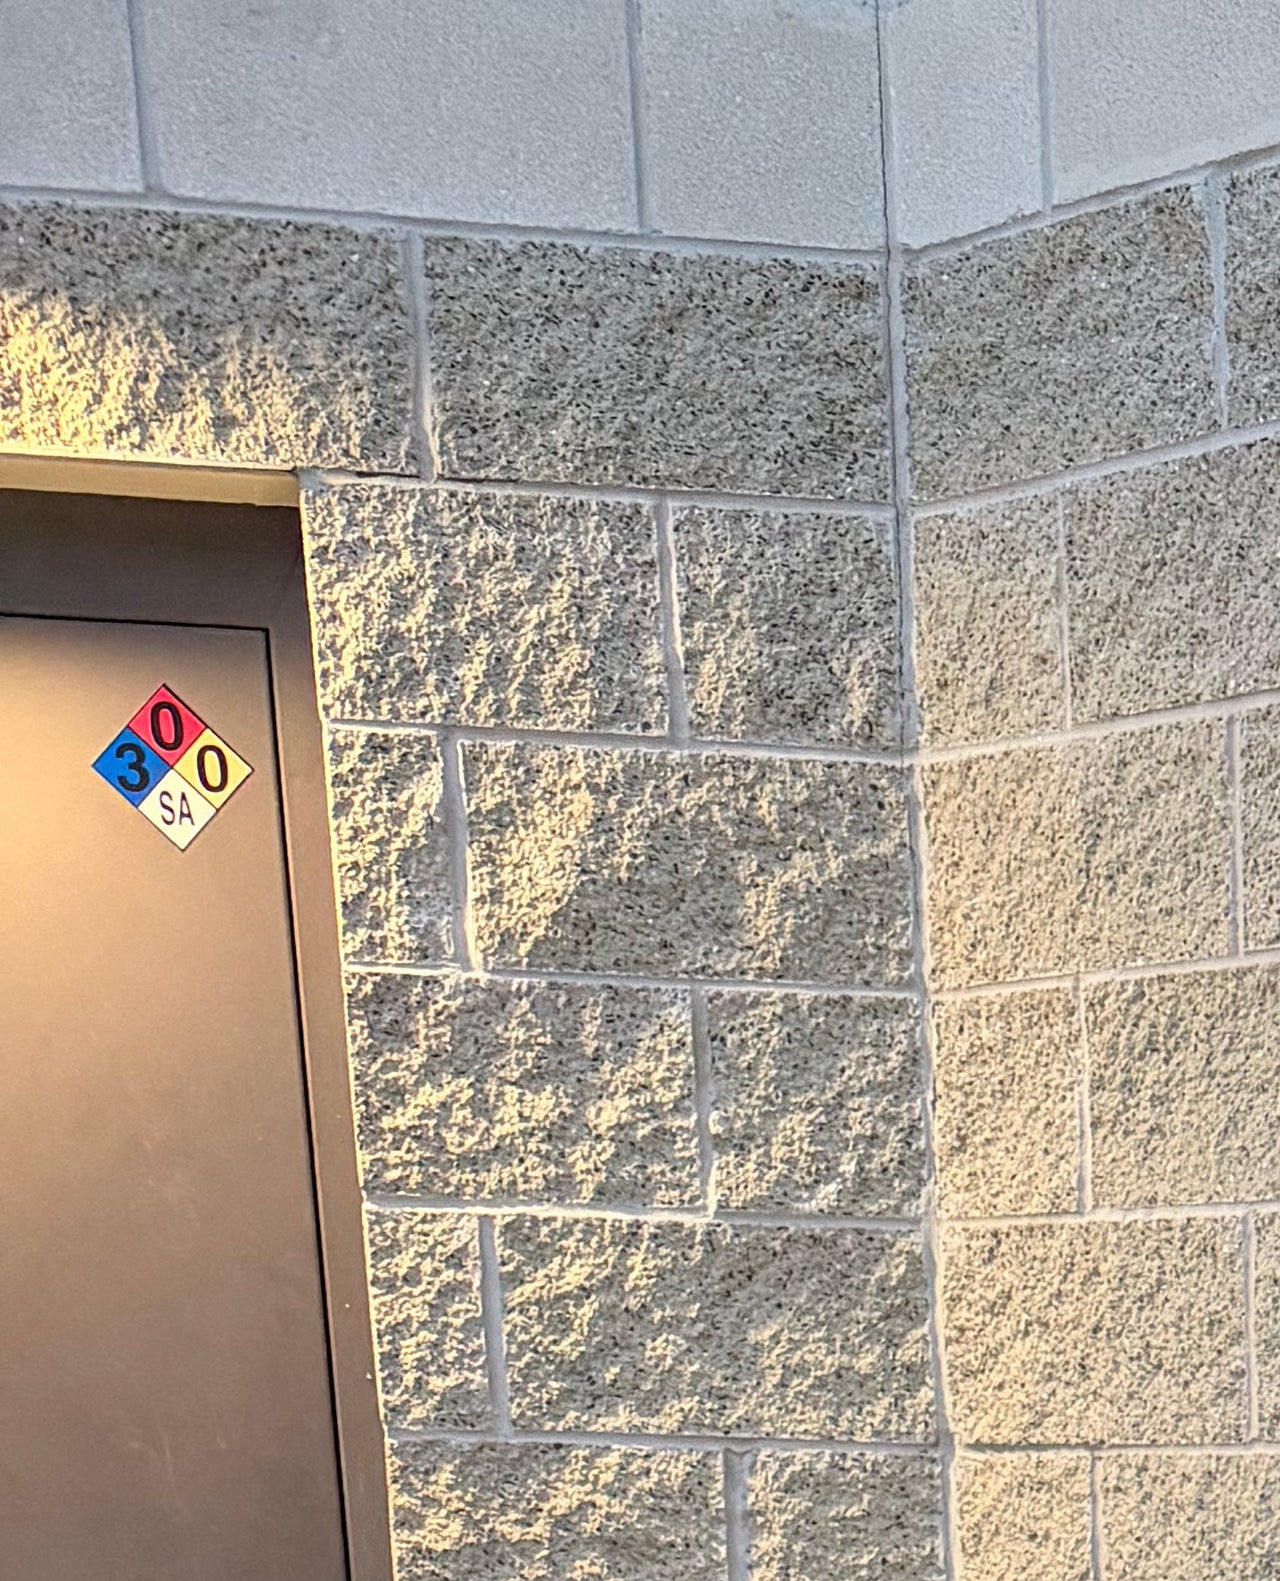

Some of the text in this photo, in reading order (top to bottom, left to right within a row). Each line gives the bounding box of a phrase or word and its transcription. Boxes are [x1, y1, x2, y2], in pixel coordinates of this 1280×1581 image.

[150, 700, 184, 751] 0
[114, 742, 149, 792] 3
[196, 744, 228, 793] 0
[158, 790, 195, 825] SA
